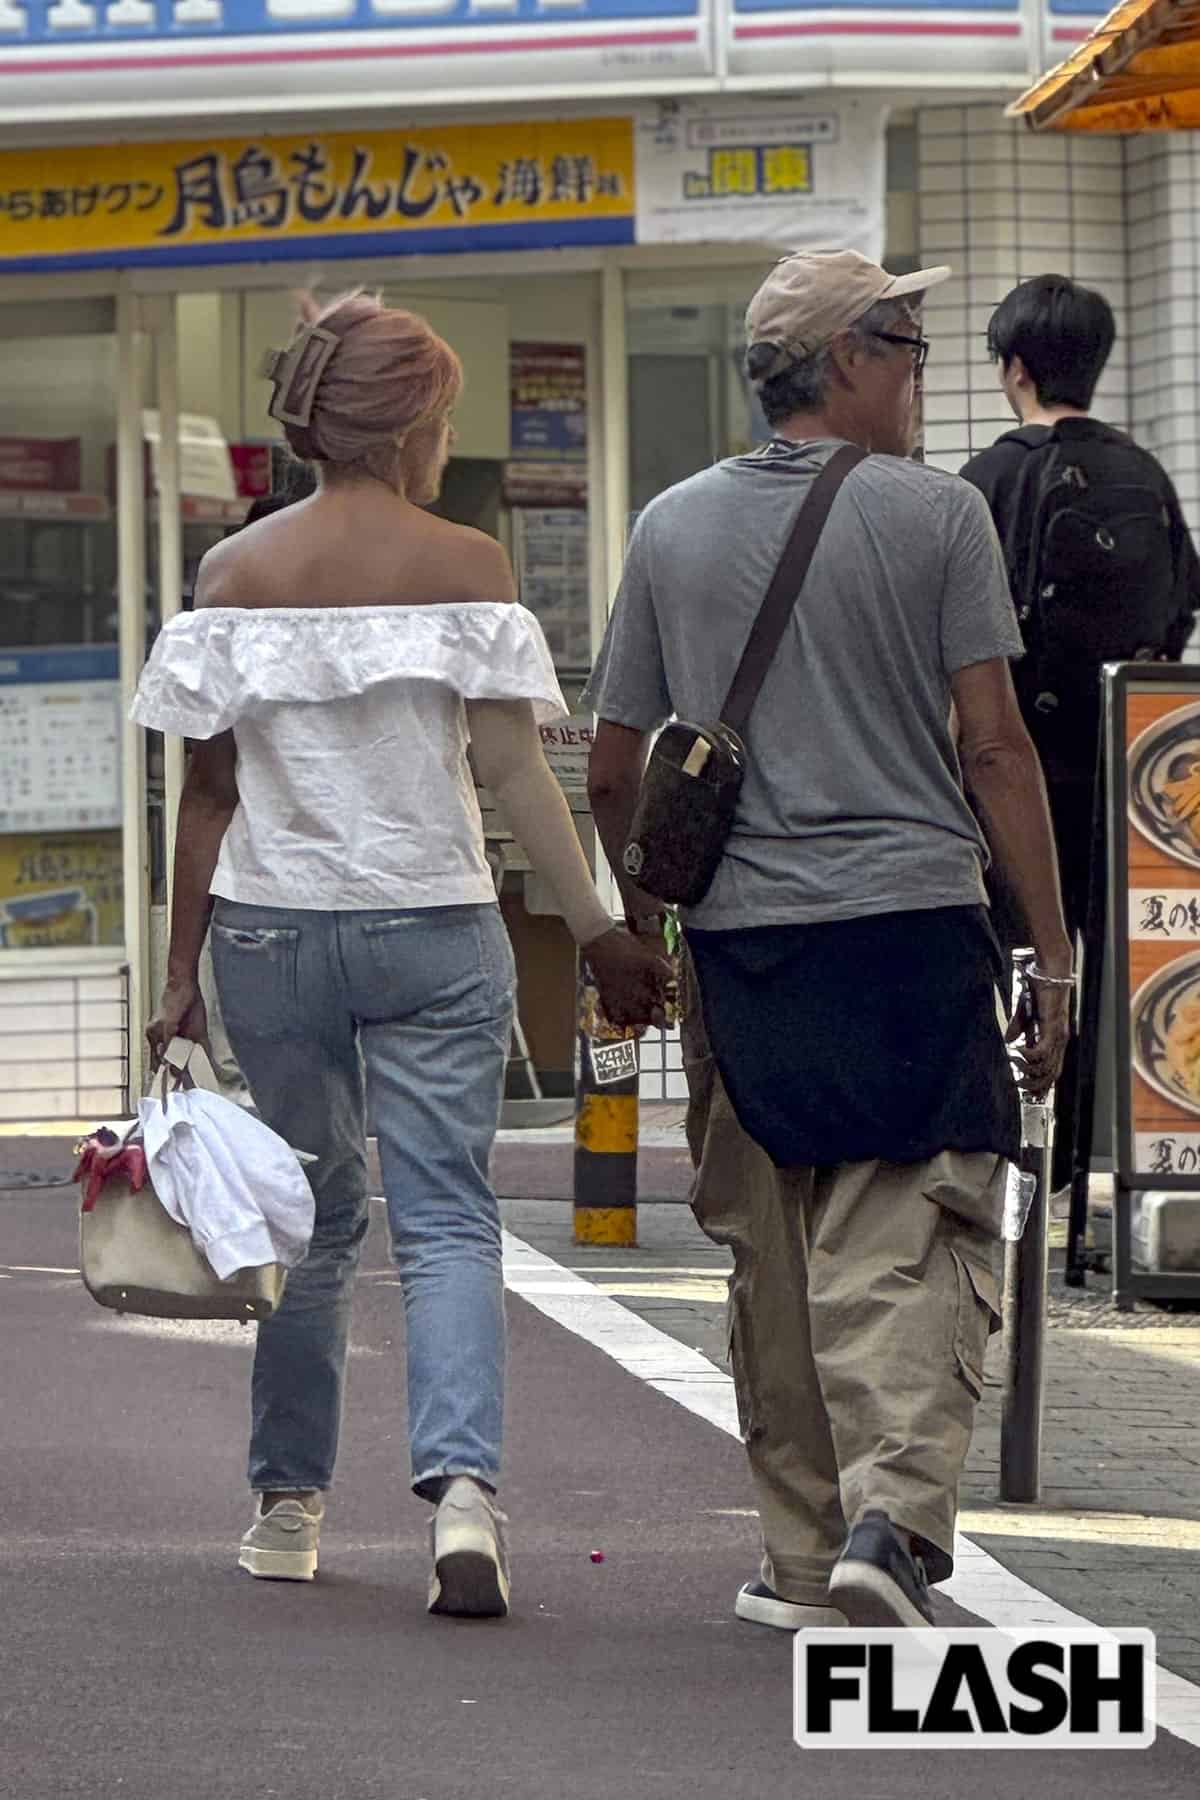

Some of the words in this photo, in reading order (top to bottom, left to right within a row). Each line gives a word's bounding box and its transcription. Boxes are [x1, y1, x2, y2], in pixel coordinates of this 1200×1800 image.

[0, 181, 164, 222] らあげクン
[1149, 1137, 1200, 1174] 夏の
